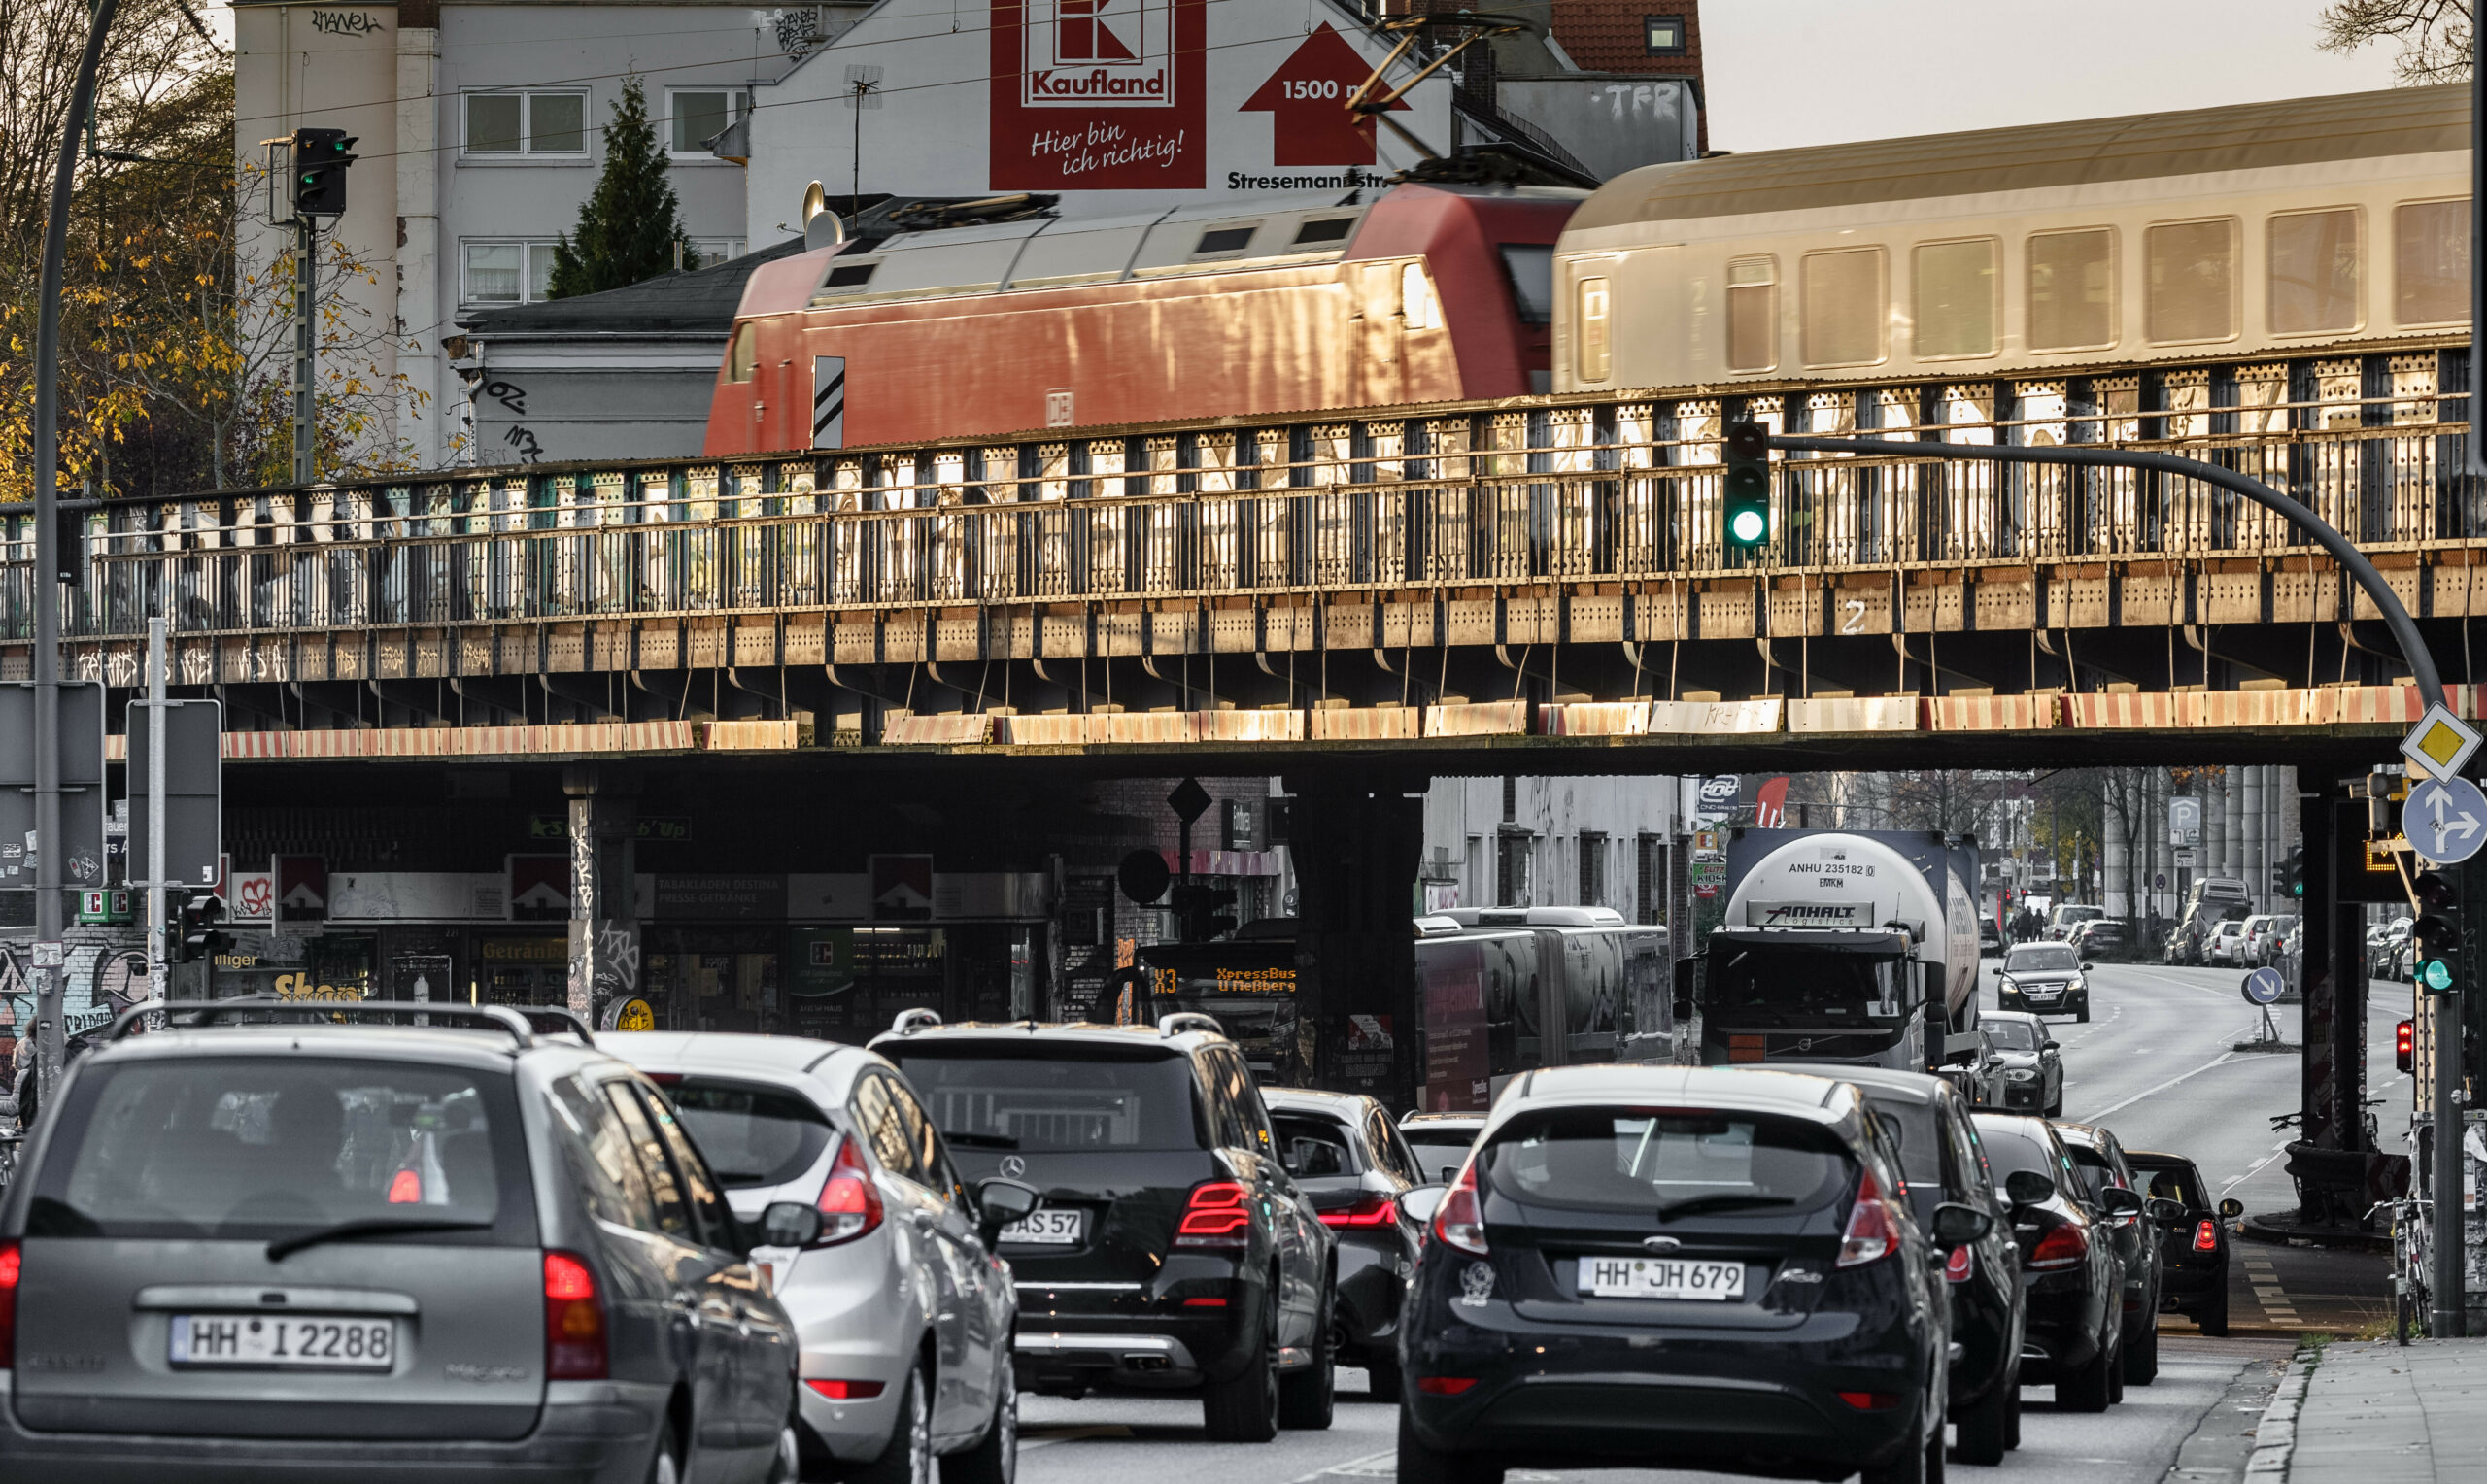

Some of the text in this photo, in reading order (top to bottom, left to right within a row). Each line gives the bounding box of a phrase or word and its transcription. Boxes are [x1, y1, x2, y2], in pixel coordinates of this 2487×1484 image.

[1032, 69, 1164, 94] Kaufland
[1283, 80, 1338, 99] 1500
[1032, 121, 1126, 157] Hier bin
[1063, 129, 1184, 175] ich richtig!
[1842, 600, 1865, 634] 2
[2177, 807, 2192, 826] P
[1789, 863, 1822, 873] ANHU
[1825, 864, 1863, 875] 235182
[733, 879, 779, 890] DESTINA
[1784, 918, 1854, 927] Logistics
[1154, 967, 1297, 995] X3 XpressBus
[1218, 980, 1229, 992] U
[1050, 1213, 1078, 1234] 57
[1595, 1262, 1741, 1290] HH JH 679
[192, 1322, 389, 1359] HH I 2288
